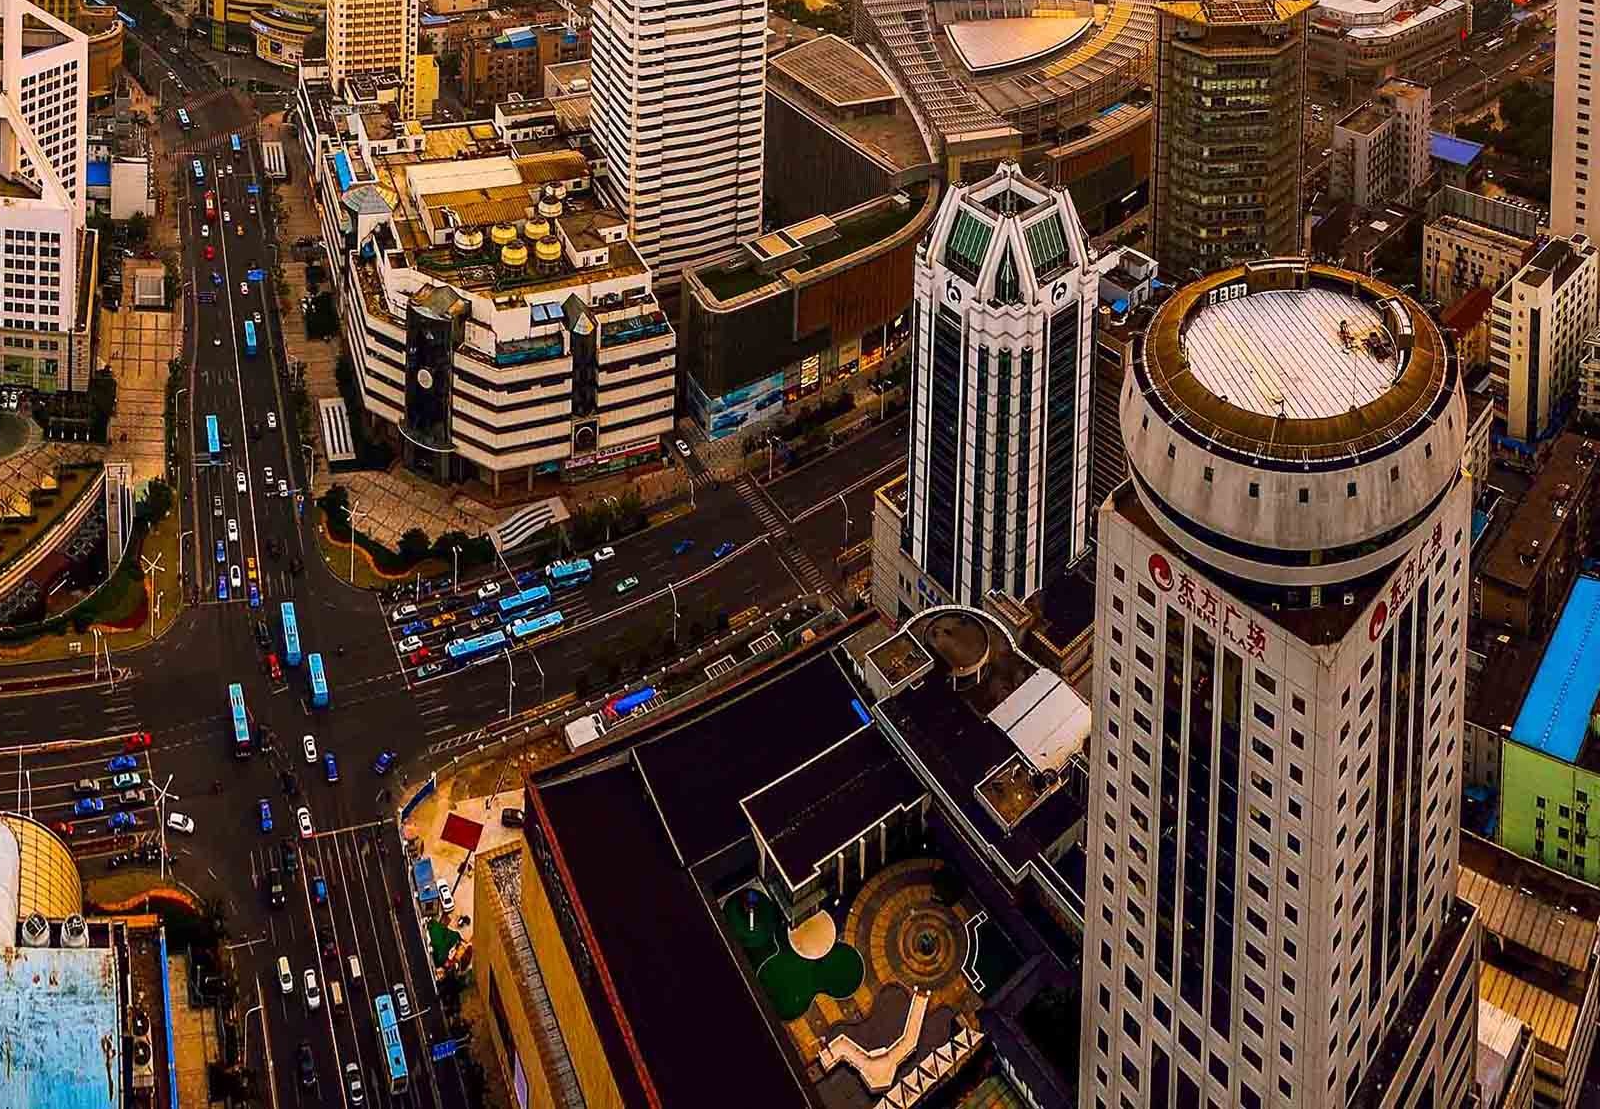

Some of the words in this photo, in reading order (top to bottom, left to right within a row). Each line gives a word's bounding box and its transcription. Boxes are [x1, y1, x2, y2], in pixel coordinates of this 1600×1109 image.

[1177, 594, 1218, 628] ORIENT
[1223, 627, 1265, 662] PLAZA
[1178, 572, 1266, 652] 东方广场
